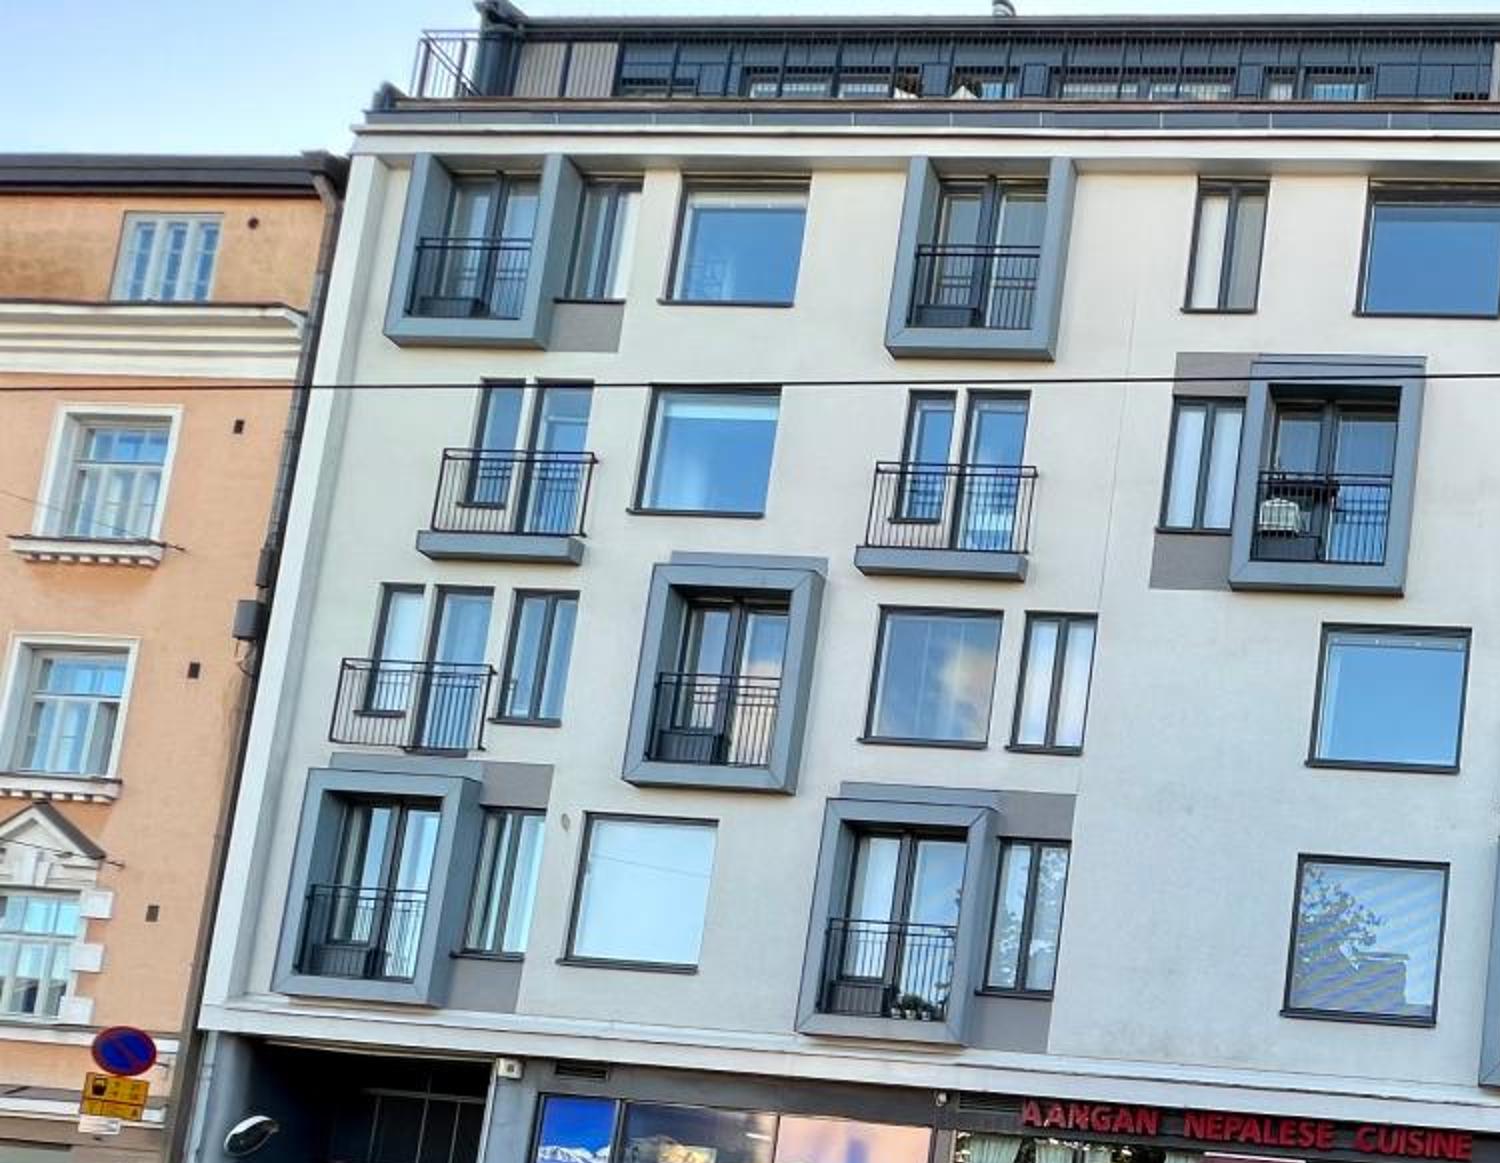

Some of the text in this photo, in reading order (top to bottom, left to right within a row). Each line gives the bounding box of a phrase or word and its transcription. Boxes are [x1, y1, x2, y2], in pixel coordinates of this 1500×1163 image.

[1022, 1100, 1473, 1162] AANGAN NEPALESE CUISINE
